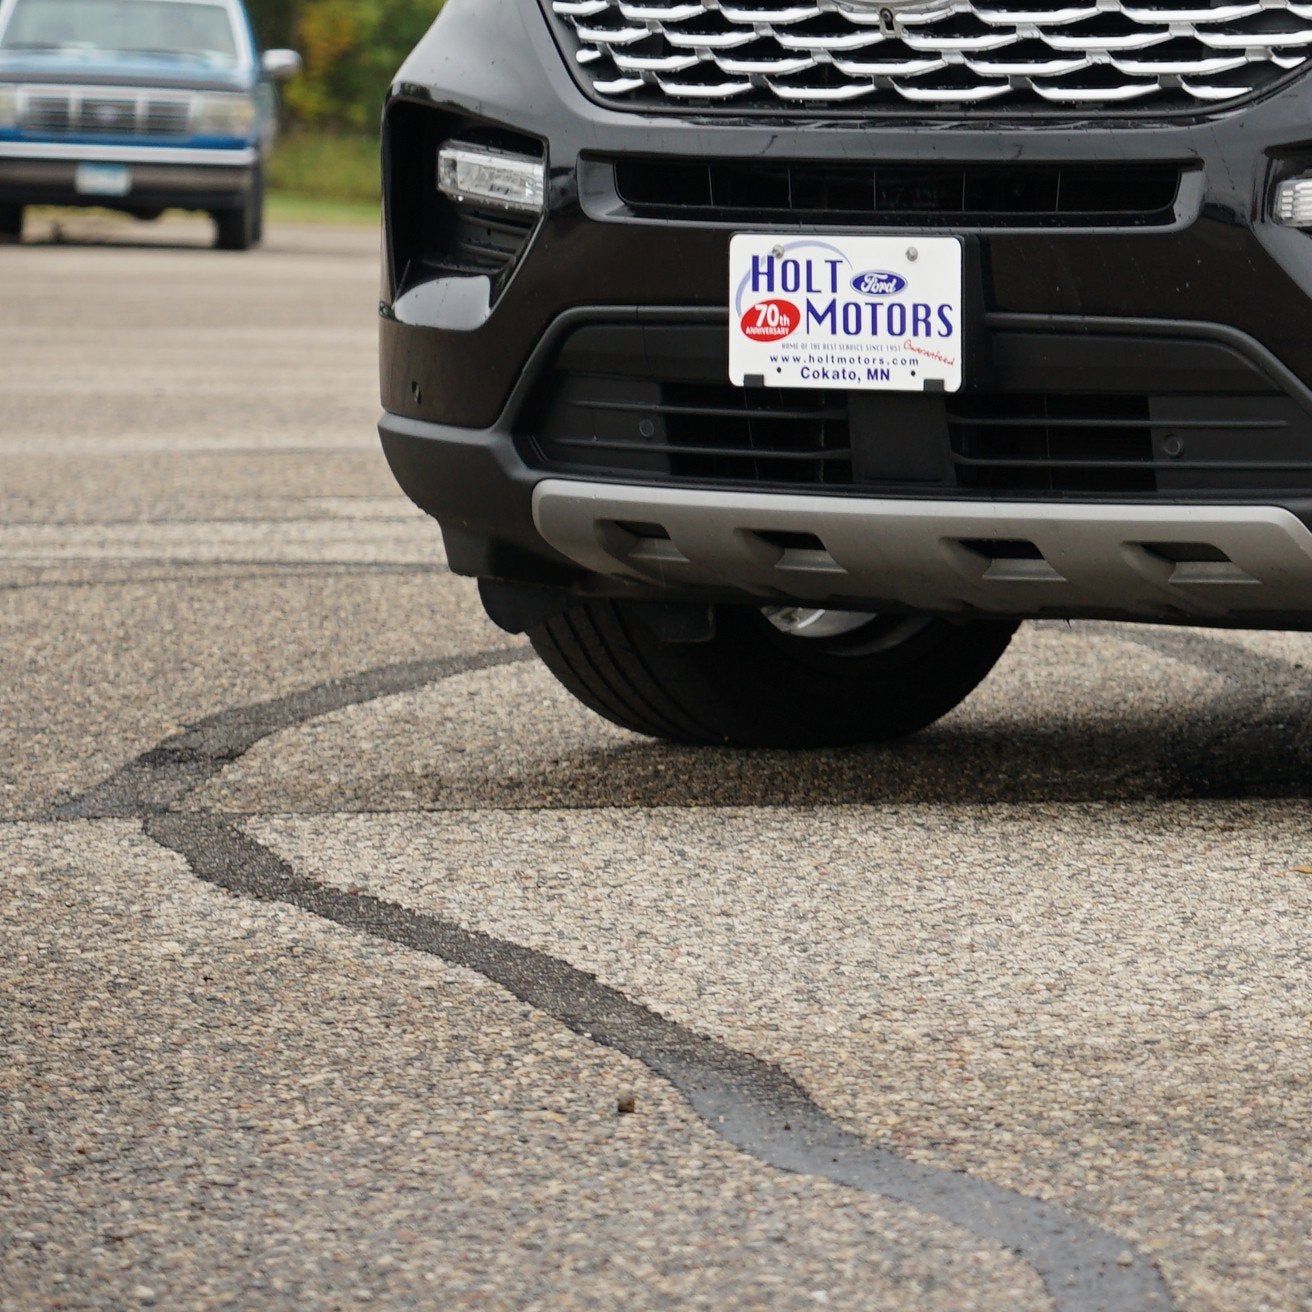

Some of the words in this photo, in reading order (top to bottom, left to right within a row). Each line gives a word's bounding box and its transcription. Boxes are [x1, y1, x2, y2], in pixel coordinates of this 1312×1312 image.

[751, 254, 843, 293] HOLT
[861, 272, 896, 294] Ford
[754, 303, 790, 327] 70th
[806, 297, 953, 338] MOTORS
[769, 353, 919, 366] www.holtmotors.com
[800, 366, 862, 383] Cokato,
[867, 368, 890, 381] MN
